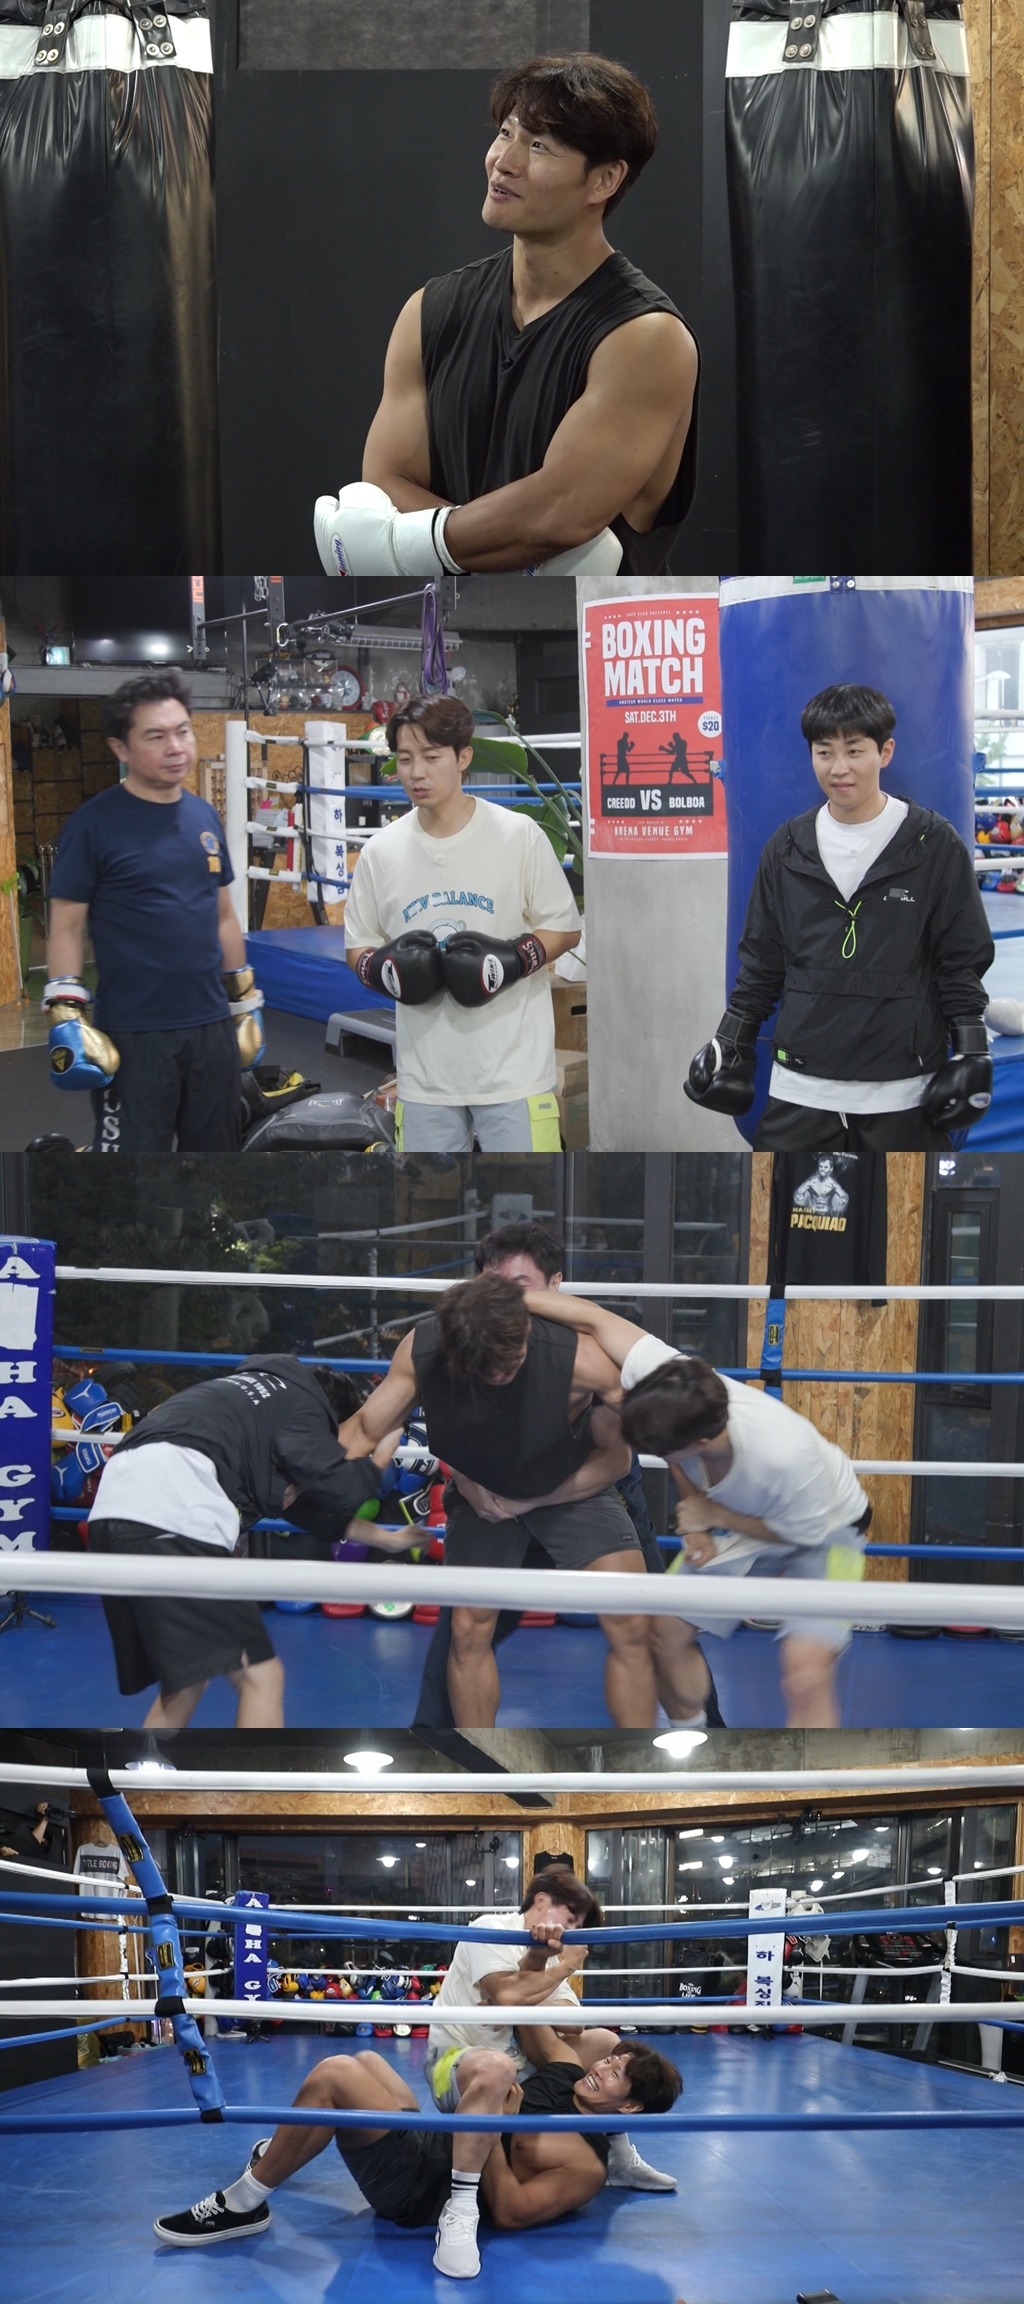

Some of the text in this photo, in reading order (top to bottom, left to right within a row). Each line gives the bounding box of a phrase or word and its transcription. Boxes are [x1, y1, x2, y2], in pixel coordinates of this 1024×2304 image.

[602, 618, 705, 659] BOXING
[604, 657, 703, 697] MATCH
[624, 710, 677, 724] SAT.DEC.3TH
[702, 721, 720, 731] $20
[640, 789, 662, 811] VS
[669, 796, 705, 808] BOLBOA
[614, 825, 693, 836] ARENA VENUE GYM
[790, 1213, 847, 1232] PACQUIAO
[0, 1464, 36, 1552] GYM
[244, 1980, 262, 2001] GY
[679, 1982, 702, 1995] BOXING
